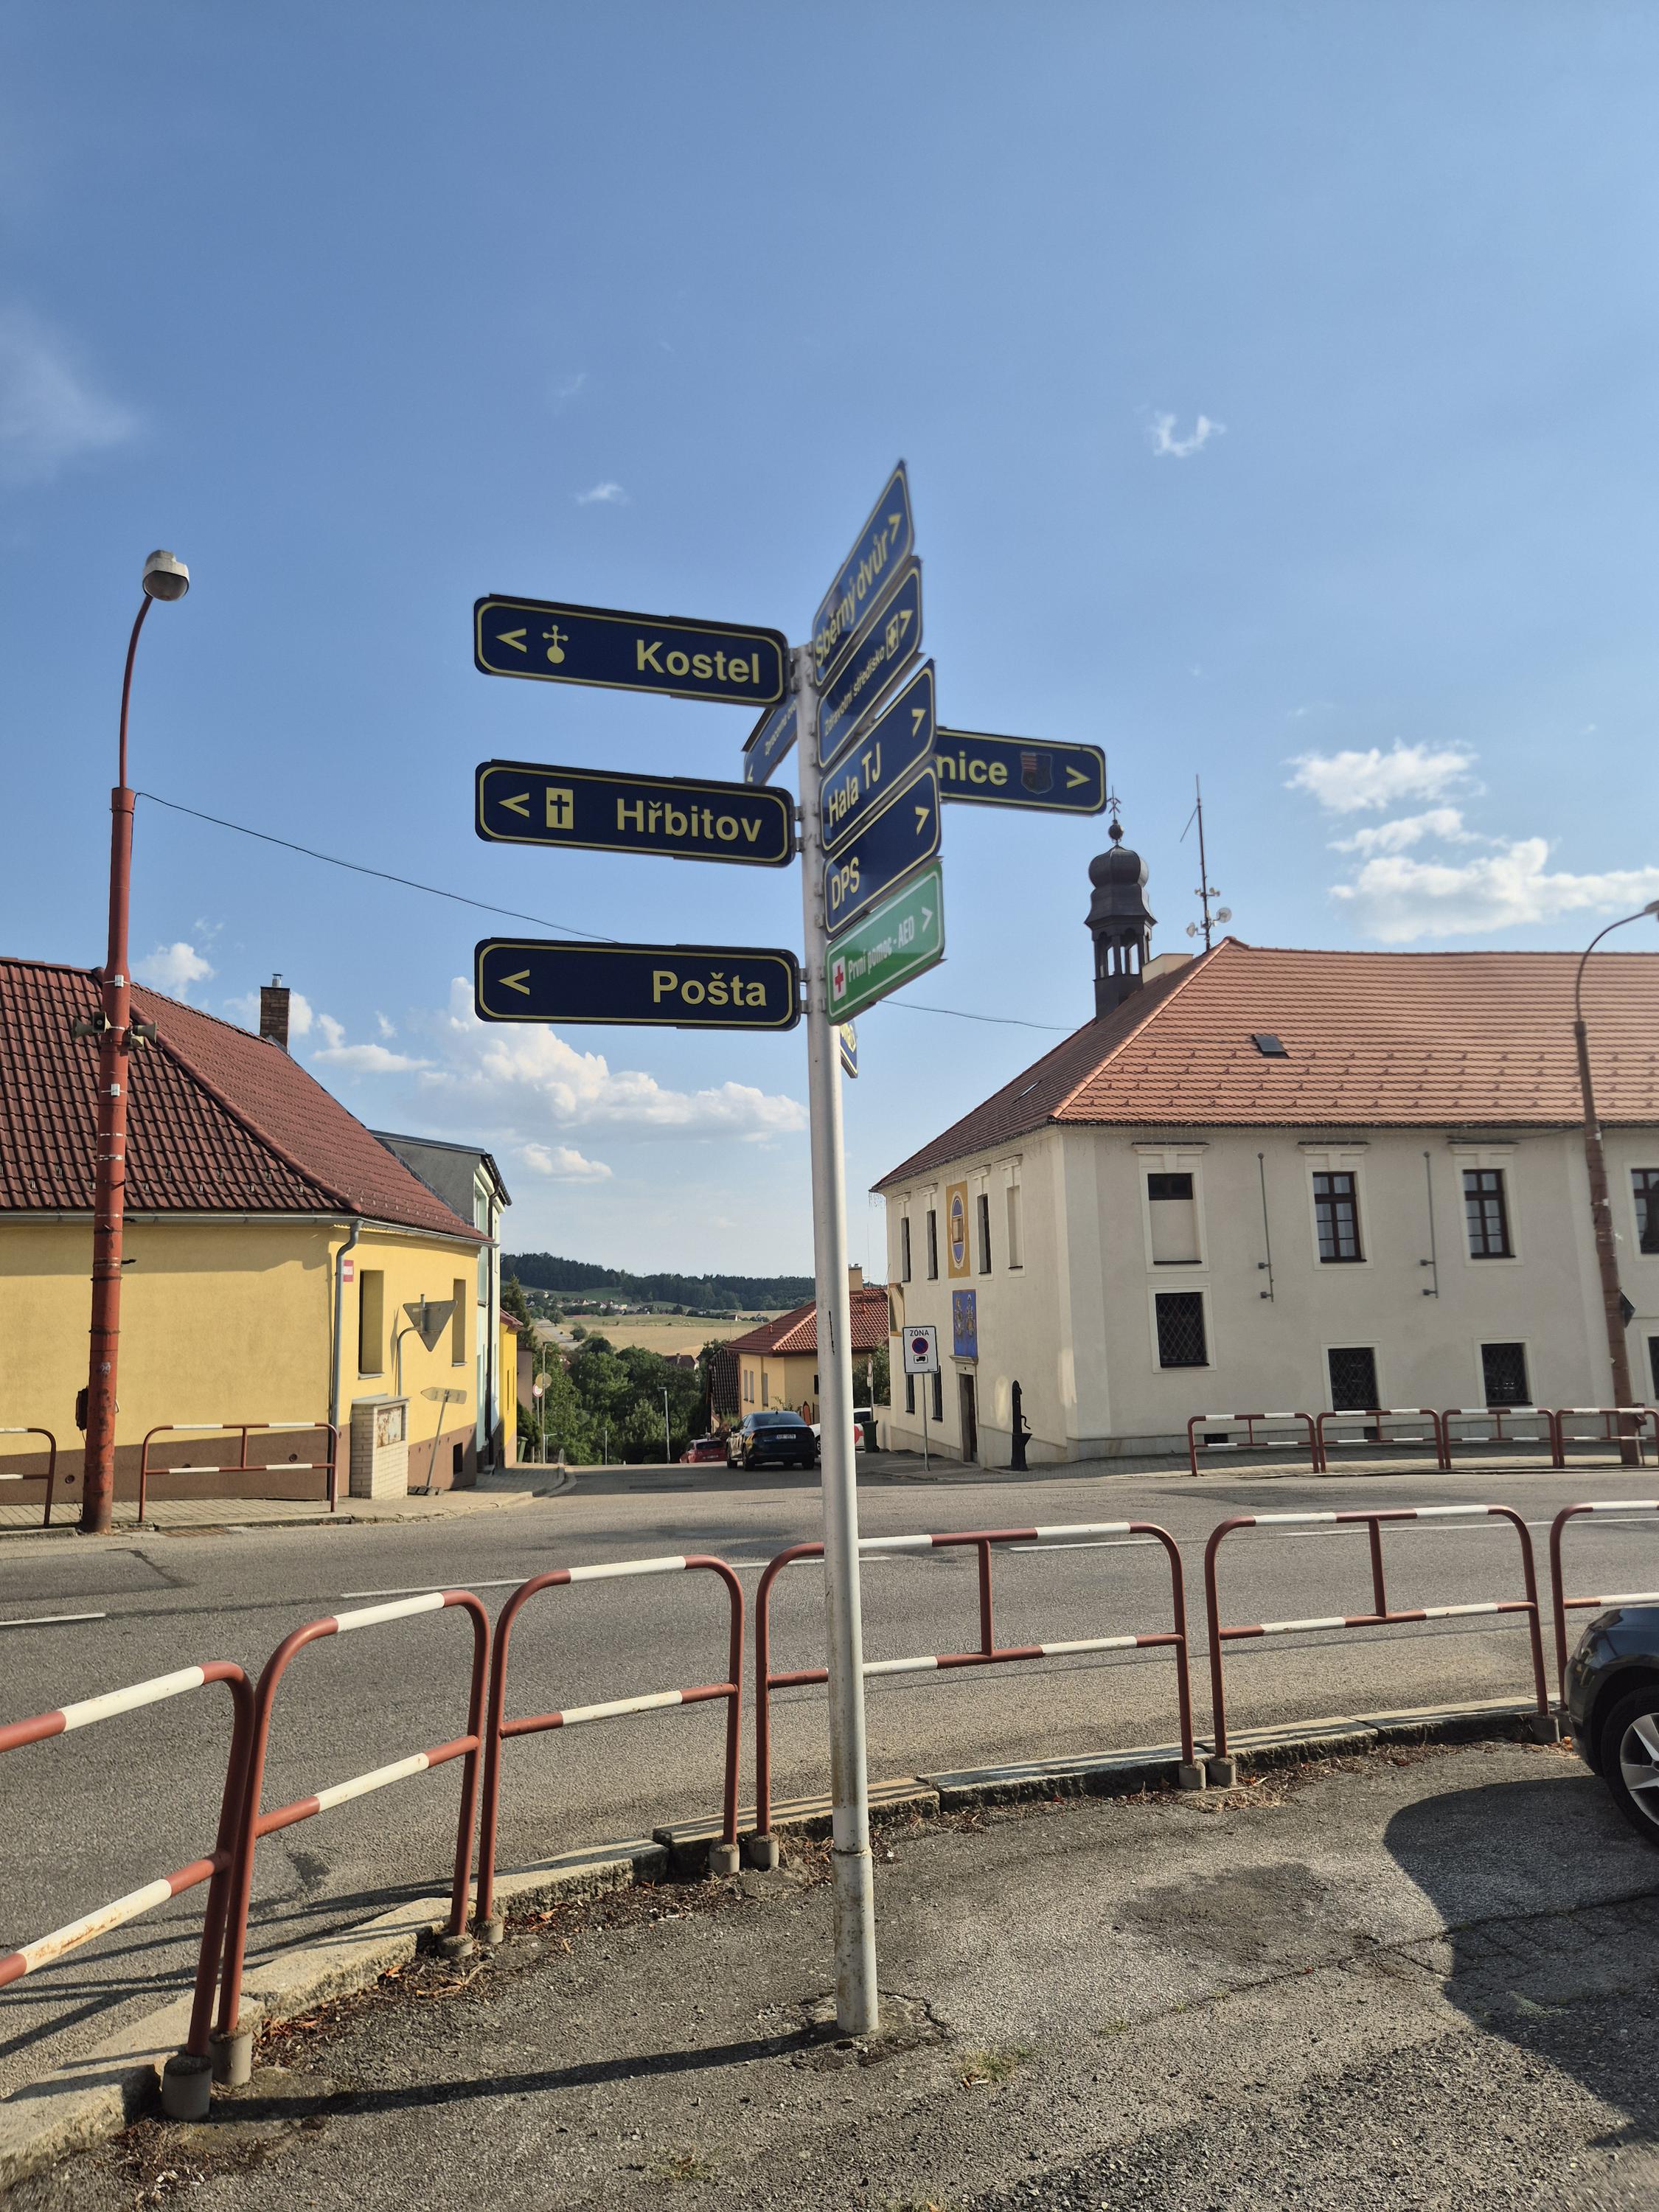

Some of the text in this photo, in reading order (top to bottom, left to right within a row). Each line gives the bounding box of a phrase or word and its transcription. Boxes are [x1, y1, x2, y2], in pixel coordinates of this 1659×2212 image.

[815, 530, 888, 668] Sběrný dvůr
[636, 639, 759, 684] Kostel
[853, 646, 885, 697] středisko
[829, 742, 881, 828] Hala TJ
[936, 751, 1008, 786] nice
[616, 798, 762, 842] Hřbitov
[832, 857, 860, 911] DPS
[848, 948, 866, 984] První
[867, 936, 893, 975] pomoc
[898, 915, 915, 950] AED
[653, 970, 767, 1006] Pošta
[909, 1329, 929, 1337] ZÓNA
